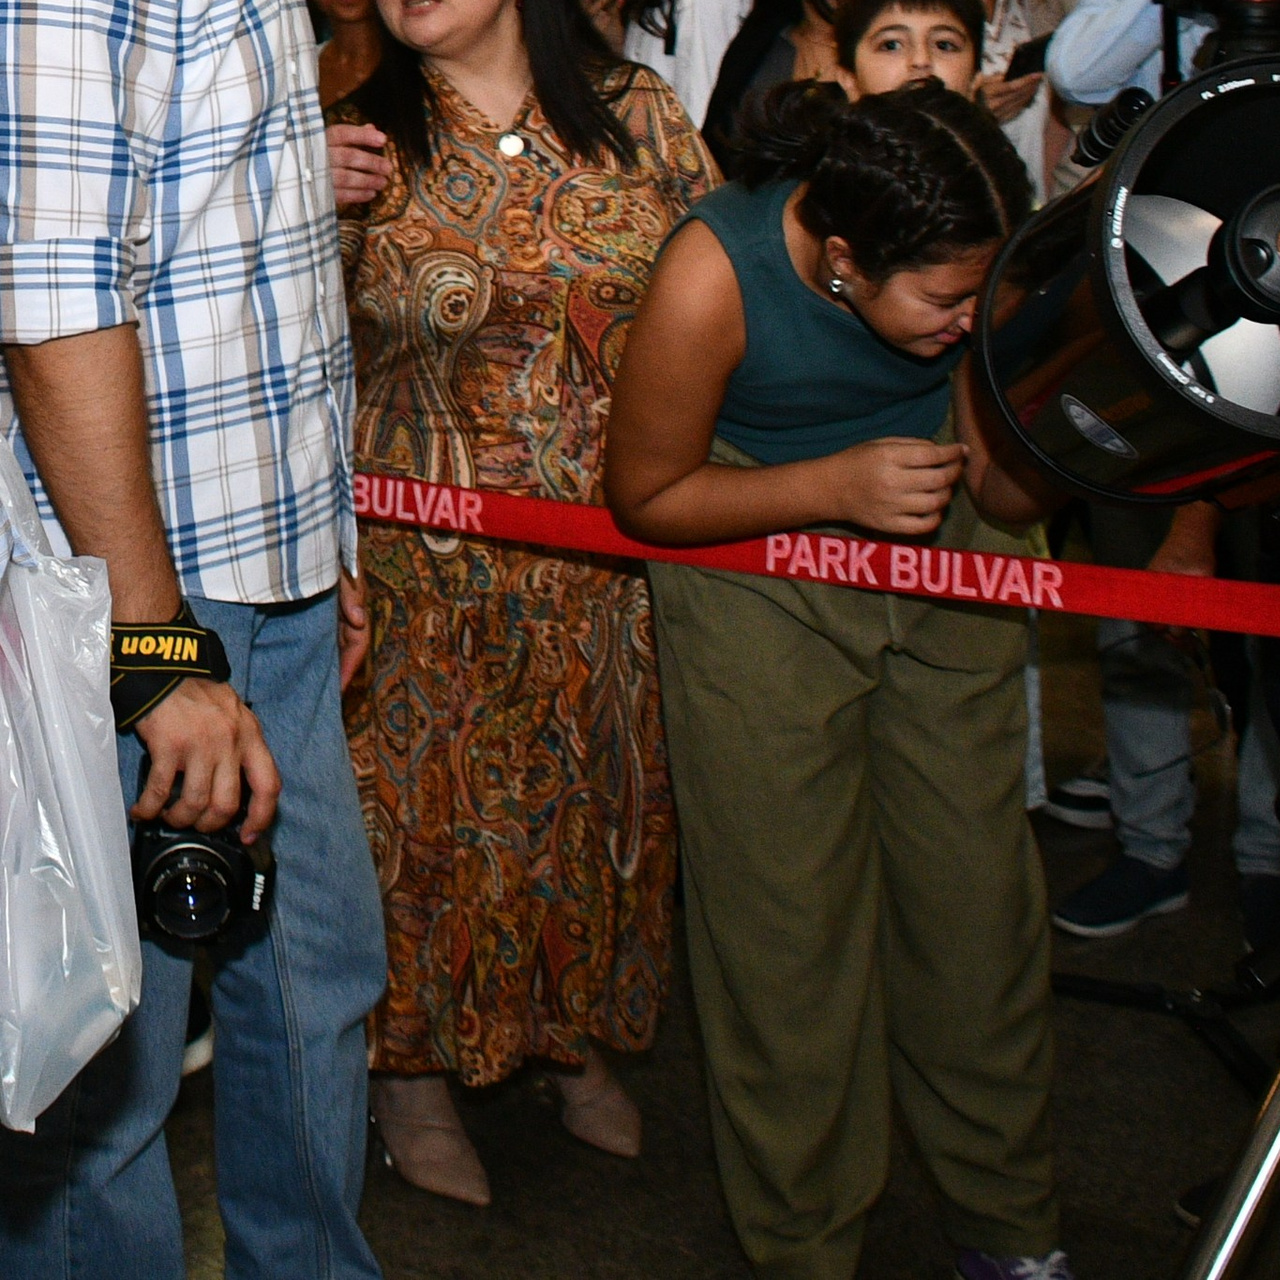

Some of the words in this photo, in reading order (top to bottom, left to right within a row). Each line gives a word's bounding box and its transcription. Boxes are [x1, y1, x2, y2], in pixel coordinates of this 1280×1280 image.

[1112, 185, 1129, 236] CELESTRON
[353, 473, 484, 533] BULVAR
[766, 532, 879, 586] PARK
[890, 545, 1064, 609] BULVAR
[121, 635, 198, 662] Nikon
[252, 872, 266, 911] Nikon
